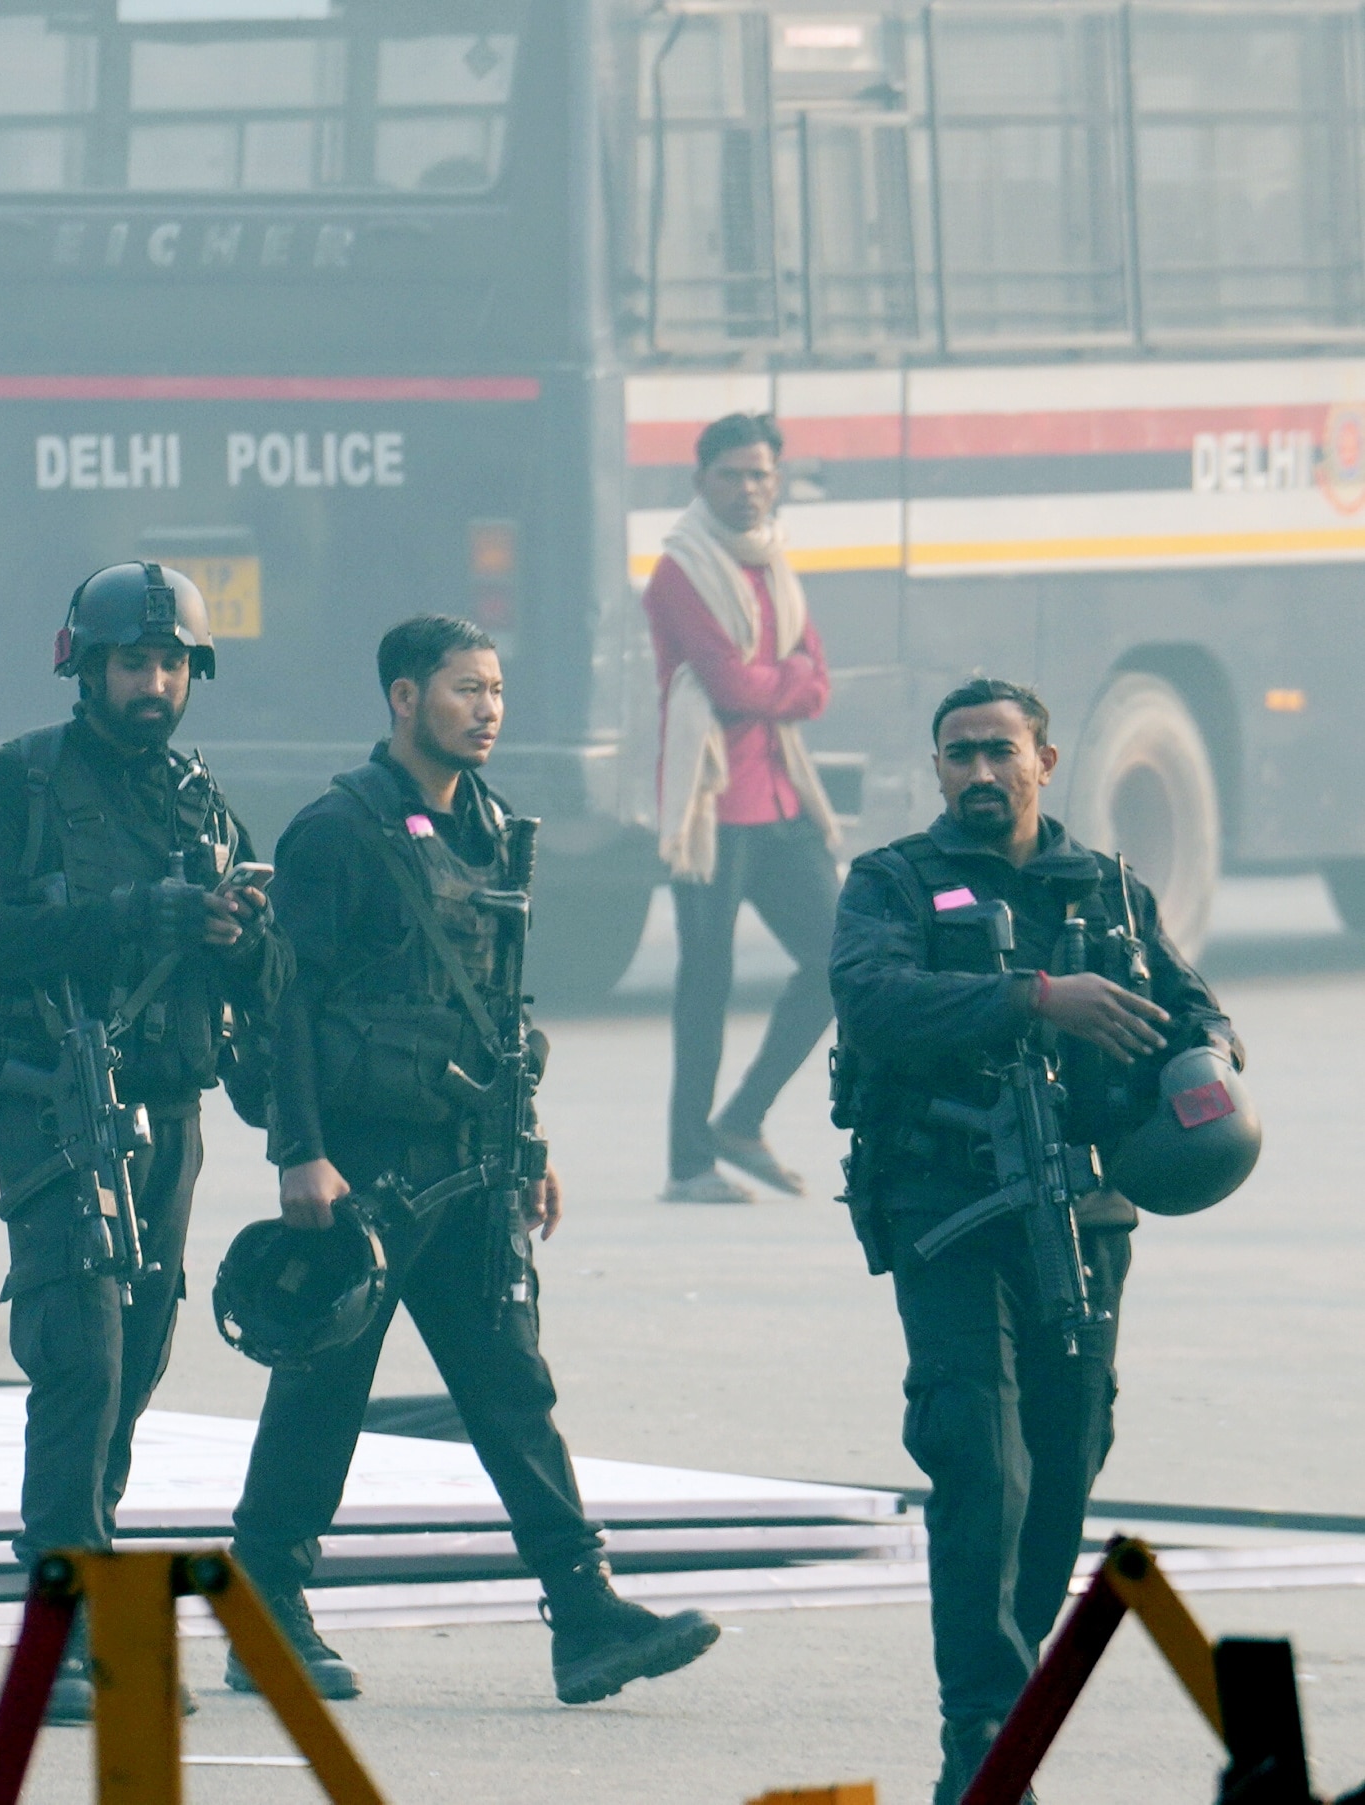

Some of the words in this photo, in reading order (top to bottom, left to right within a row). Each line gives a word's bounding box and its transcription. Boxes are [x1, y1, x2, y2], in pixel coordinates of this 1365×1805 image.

[52, 222, 356, 268] EICHER
[36, 434, 181, 489] DELHI
[227, 432, 404, 487] POLICE
[1192, 430, 1313, 490] DELHI
